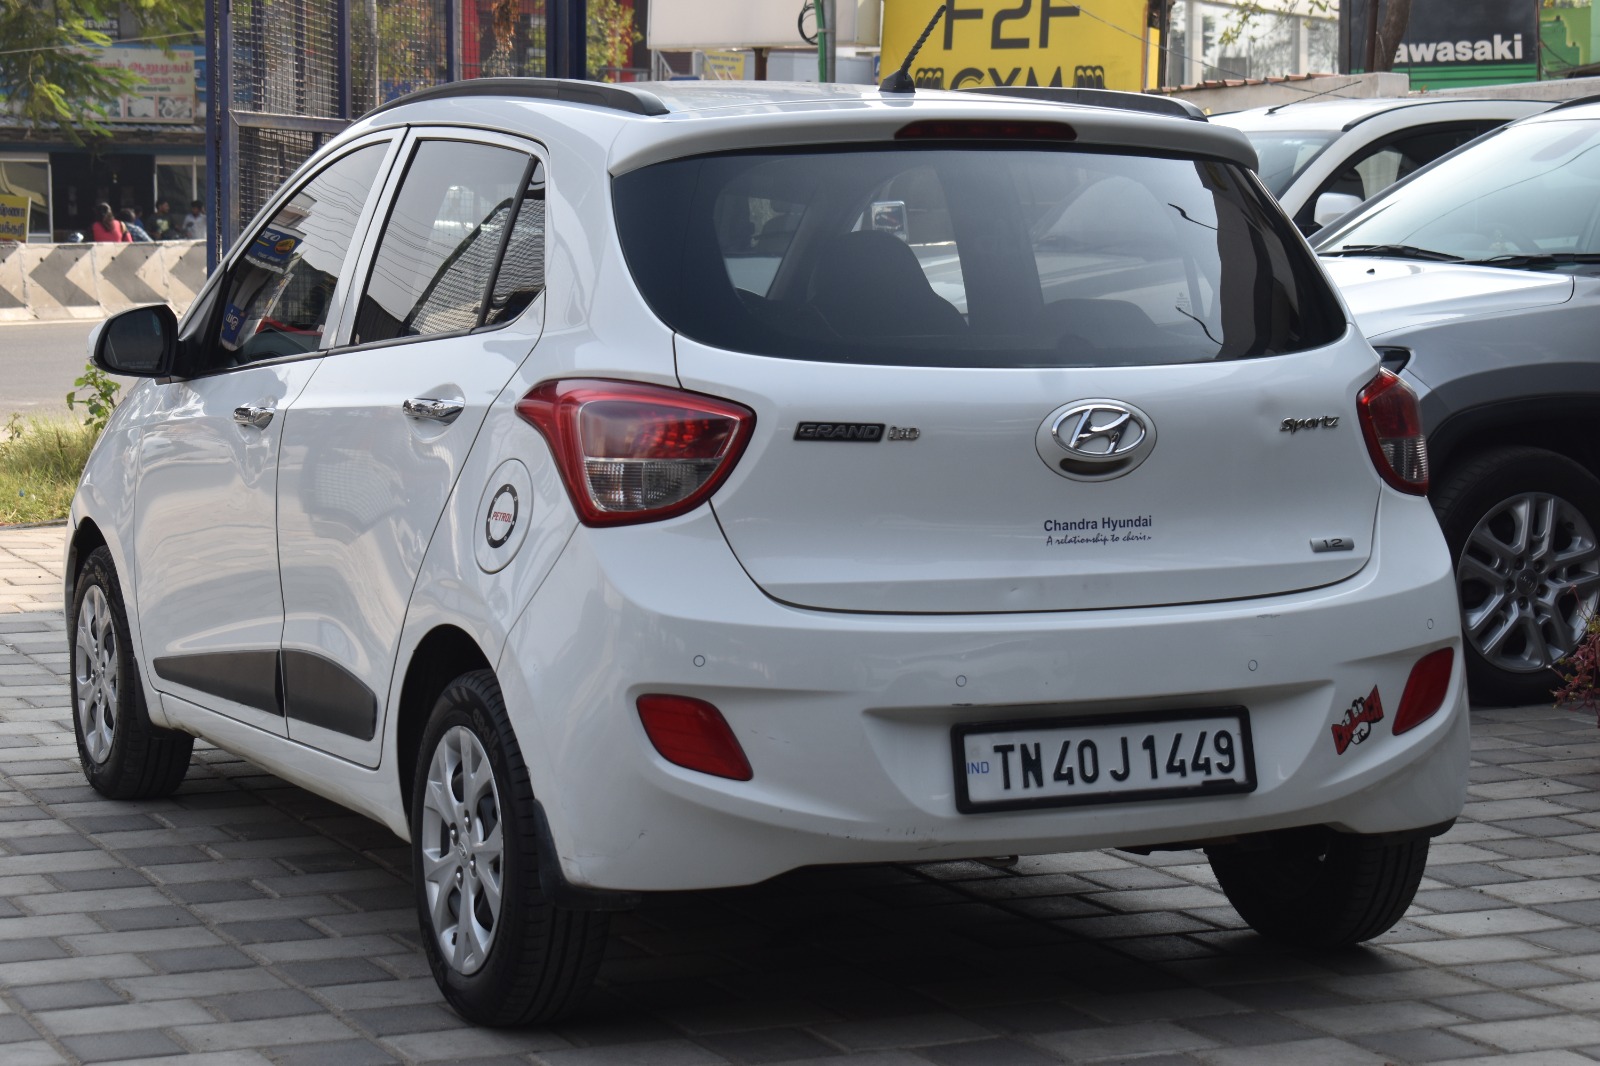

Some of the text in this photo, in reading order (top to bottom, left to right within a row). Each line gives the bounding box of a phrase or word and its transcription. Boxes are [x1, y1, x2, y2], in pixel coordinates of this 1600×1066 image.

[1393, 33, 1523, 63] awasaki
[797, 423, 882, 440] GRAND
[1279, 415, 1340, 434] Sportz
[491, 511, 513, 523] PETROL
[1043, 515, 1152, 531] Chandra Hyundai
[1046, 535, 1053, 546] A
[1055, 533, 1108, 545] relationship
[1110, 534, 1120, 542] to
[993, 729, 1236, 790] TN 40 J 1449
[966, 761, 990, 775] IND
